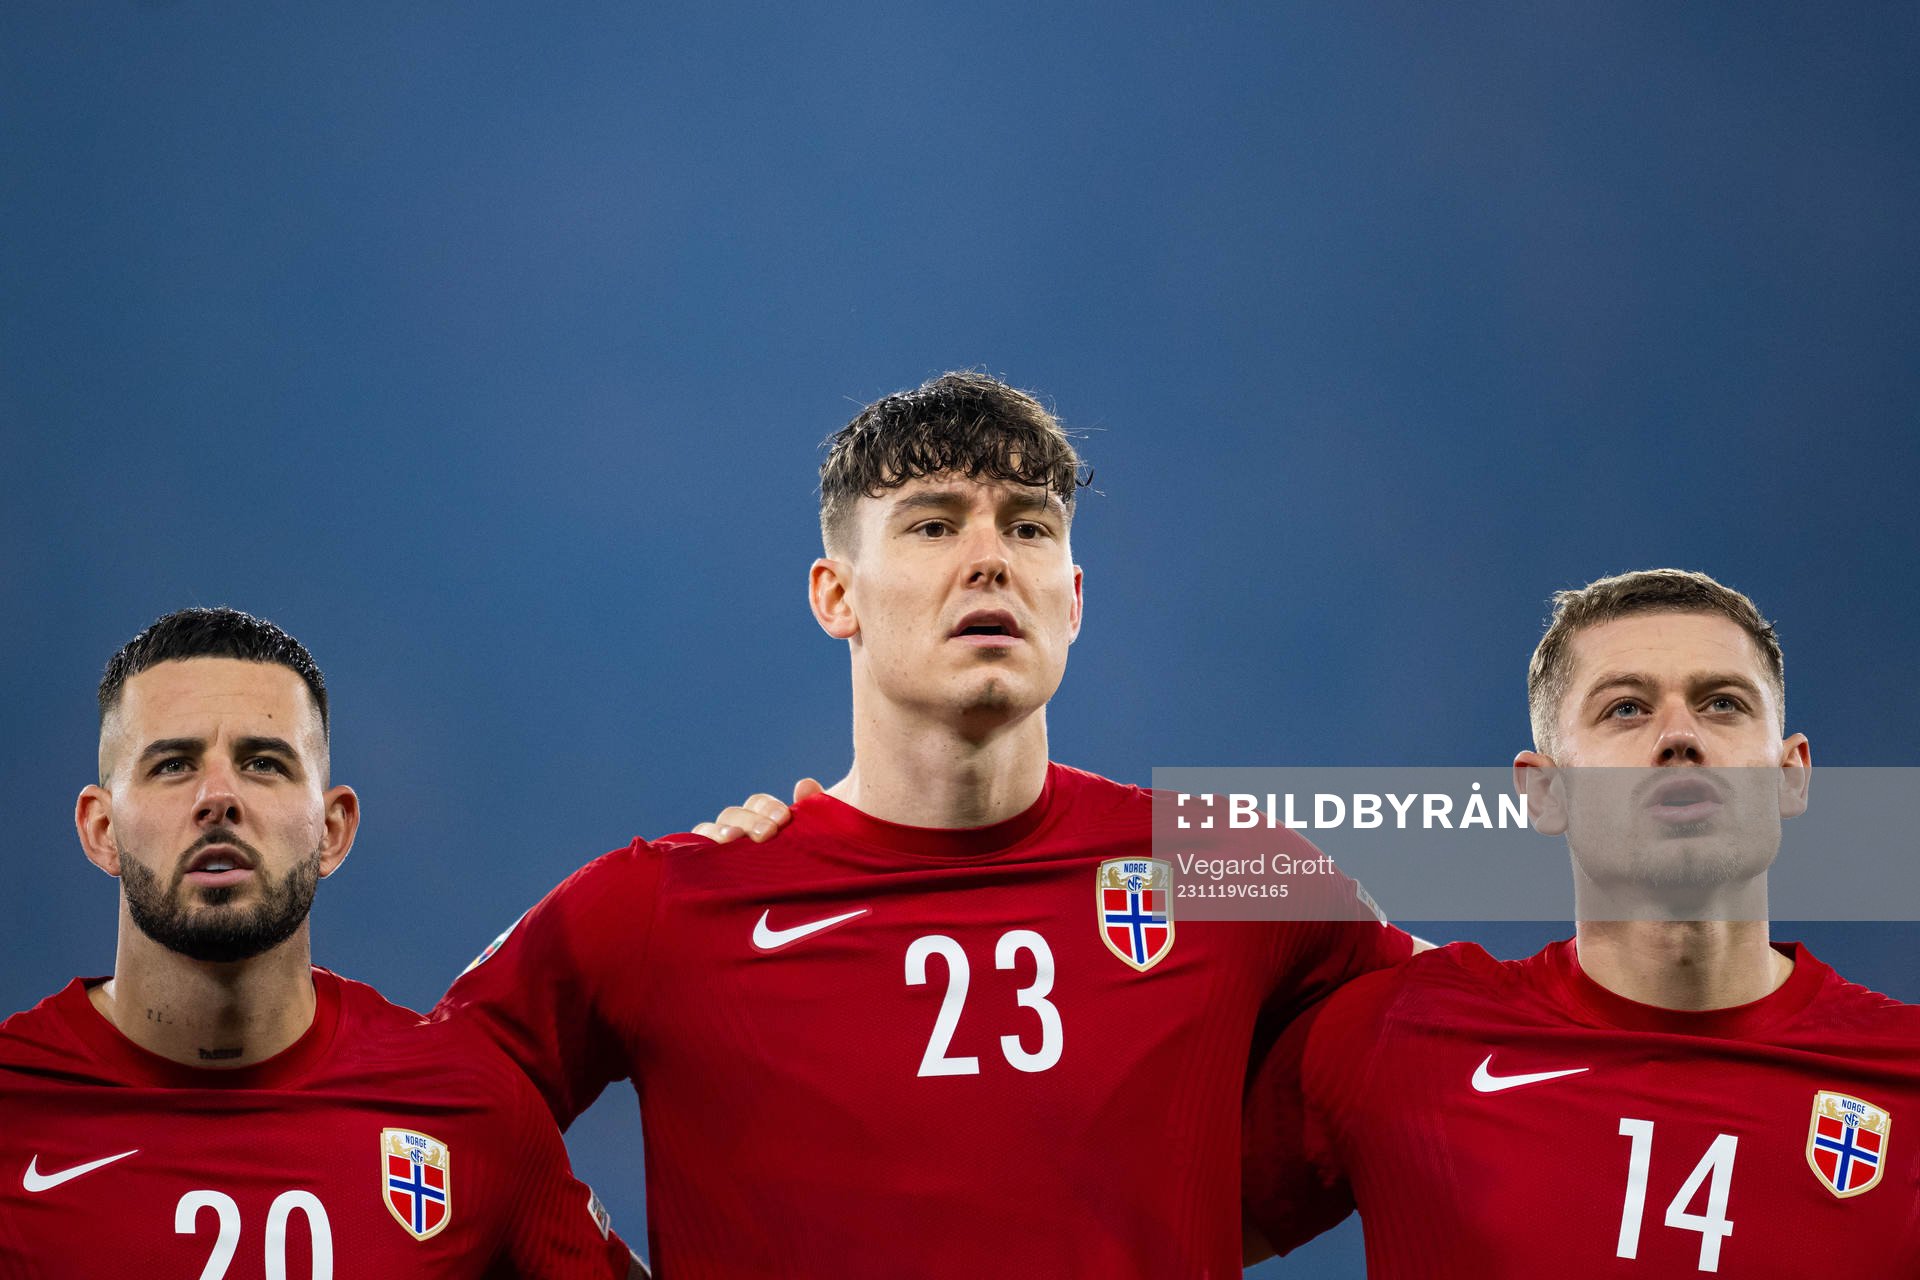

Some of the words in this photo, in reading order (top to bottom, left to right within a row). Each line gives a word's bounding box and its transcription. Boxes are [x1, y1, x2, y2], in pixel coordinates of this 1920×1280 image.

[1123, 863, 1147, 873] NORGE
[904, 929, 1064, 1077] 23
[1841, 1098, 1866, 1114] NORGE
[405, 1134, 427, 1149] NORGE
[1616, 1117, 1739, 1273] 14
[174, 1189, 334, 1280] 20
